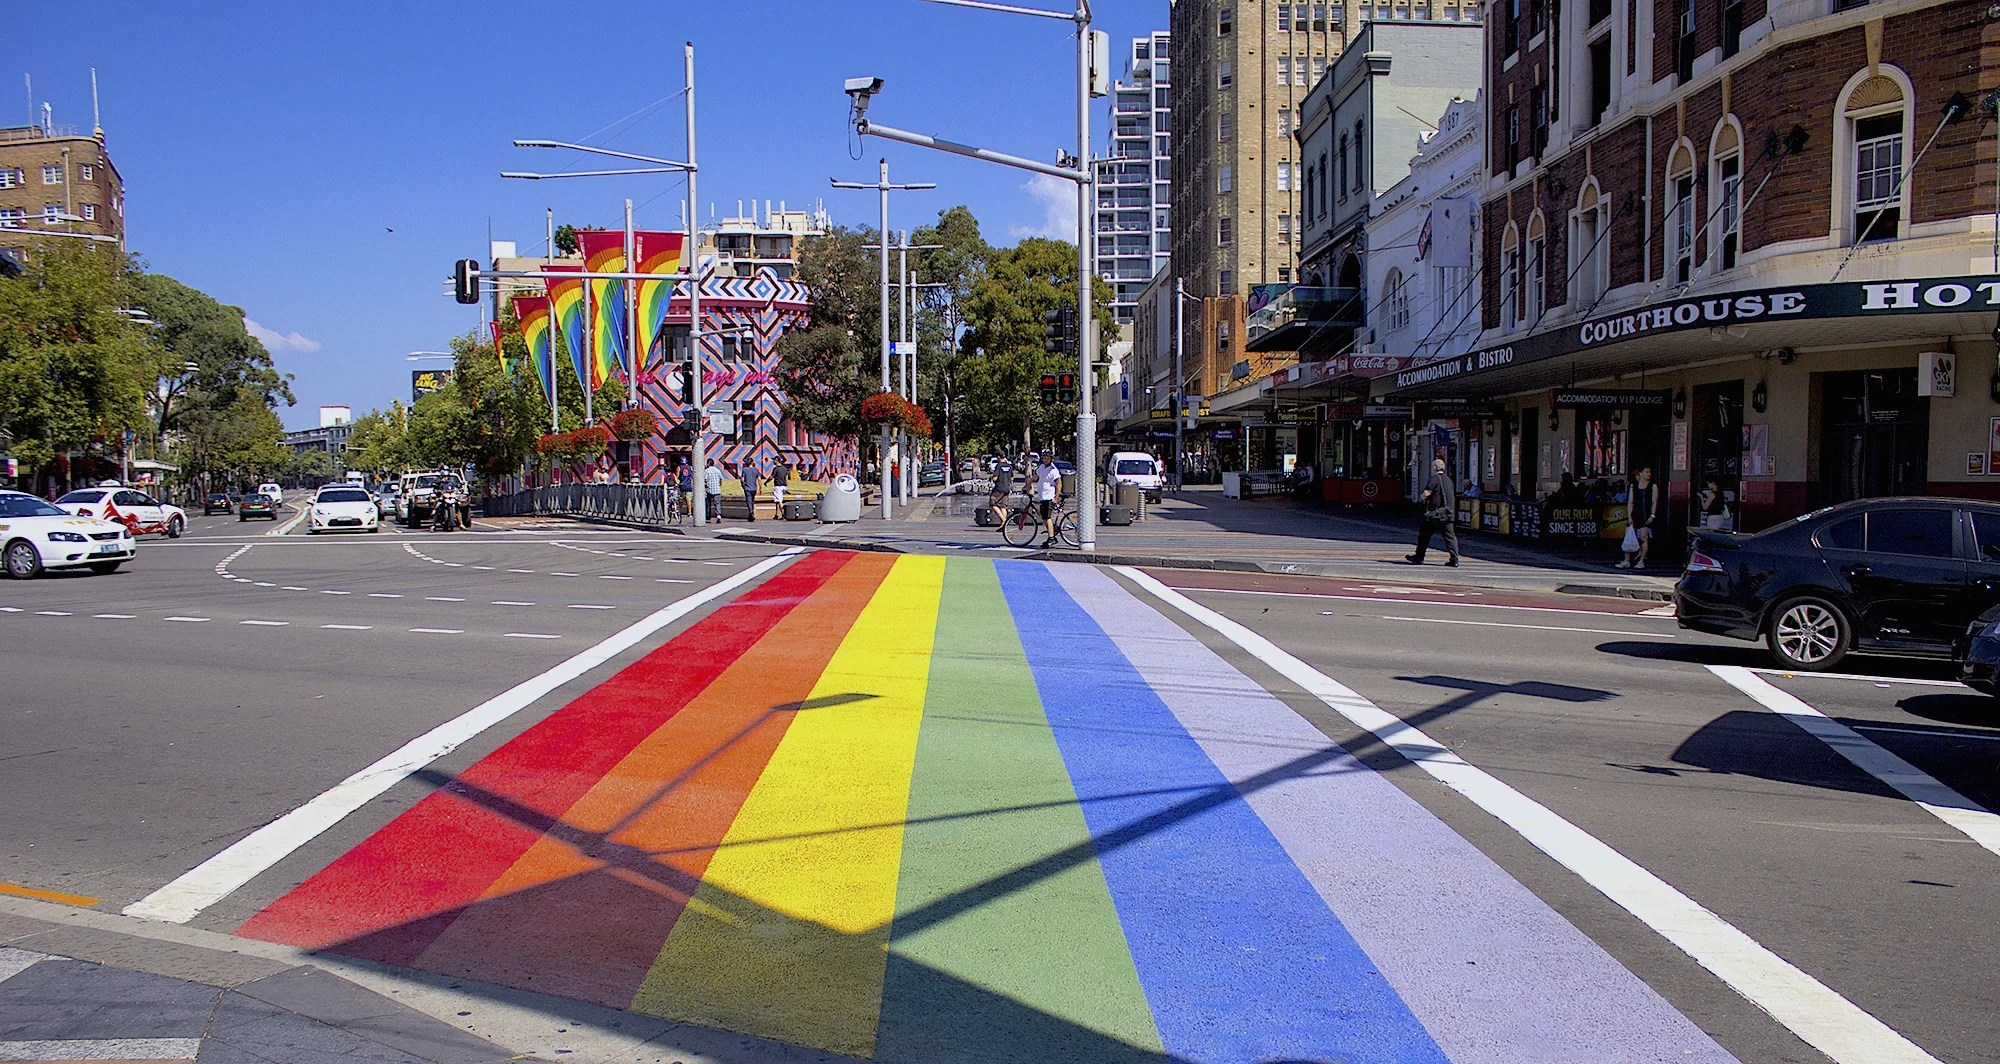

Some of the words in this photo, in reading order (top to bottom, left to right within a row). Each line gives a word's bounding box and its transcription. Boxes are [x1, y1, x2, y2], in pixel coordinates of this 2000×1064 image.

[1444, 112, 1460, 135] 1887
[1579, 292, 1807, 345] COURTHOUSE
[1397, 360, 1461, 388] ACCOMMODATION
[1466, 356, 1473, 372] &
[1479, 346, 1514, 370] BISTRO
[1556, 394, 1617, 404] ACCOMMODATION
[1635, 395, 1664, 405] LOUNGE
[1553, 508, 1571, 520] OUR
[1572, 508, 1593, 520] RUM
[1549, 521, 1575, 534] SINCE
[1576, 521, 1597, 534] 1888
